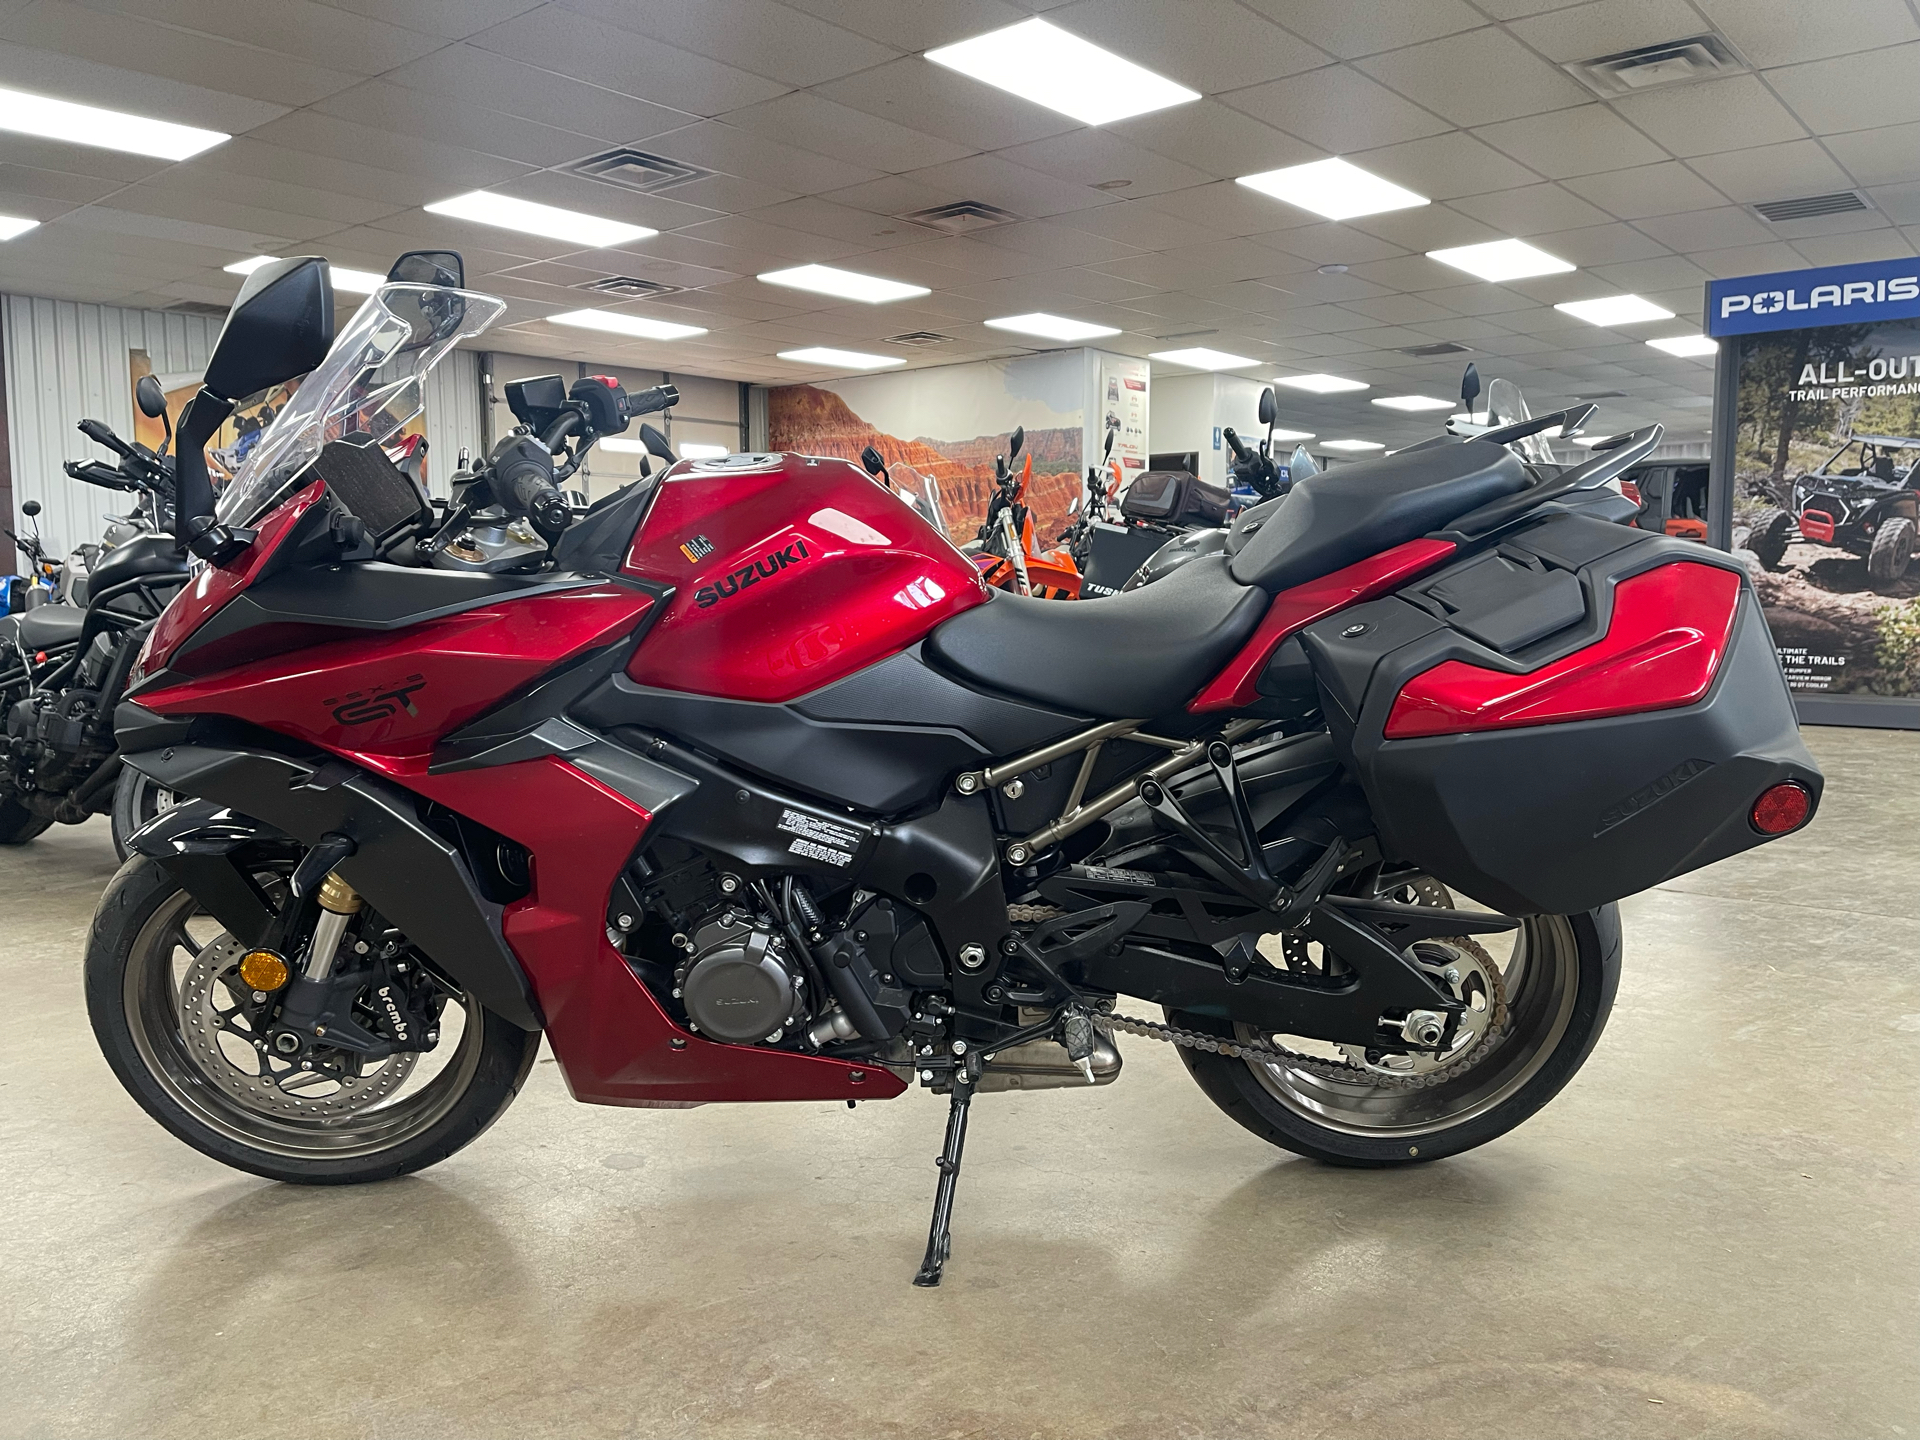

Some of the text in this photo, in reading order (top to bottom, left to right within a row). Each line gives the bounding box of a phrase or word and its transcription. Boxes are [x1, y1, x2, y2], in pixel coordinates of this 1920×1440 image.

[1721, 276, 1920, 319] POLARIS
[1798, 355, 1920, 386] ALL-OUT
[1789, 383, 1920, 402] TRAIL PERFORMAN
[694, 540, 810, 609] SUZUKI
[1785, 655, 1806, 665] THE
[1808, 656, 1846, 666] TRAILS
[332, 682, 428, 725] GT
[1601, 760, 1699, 826] SUZUKI
[378, 986, 408, 1041] brembo
